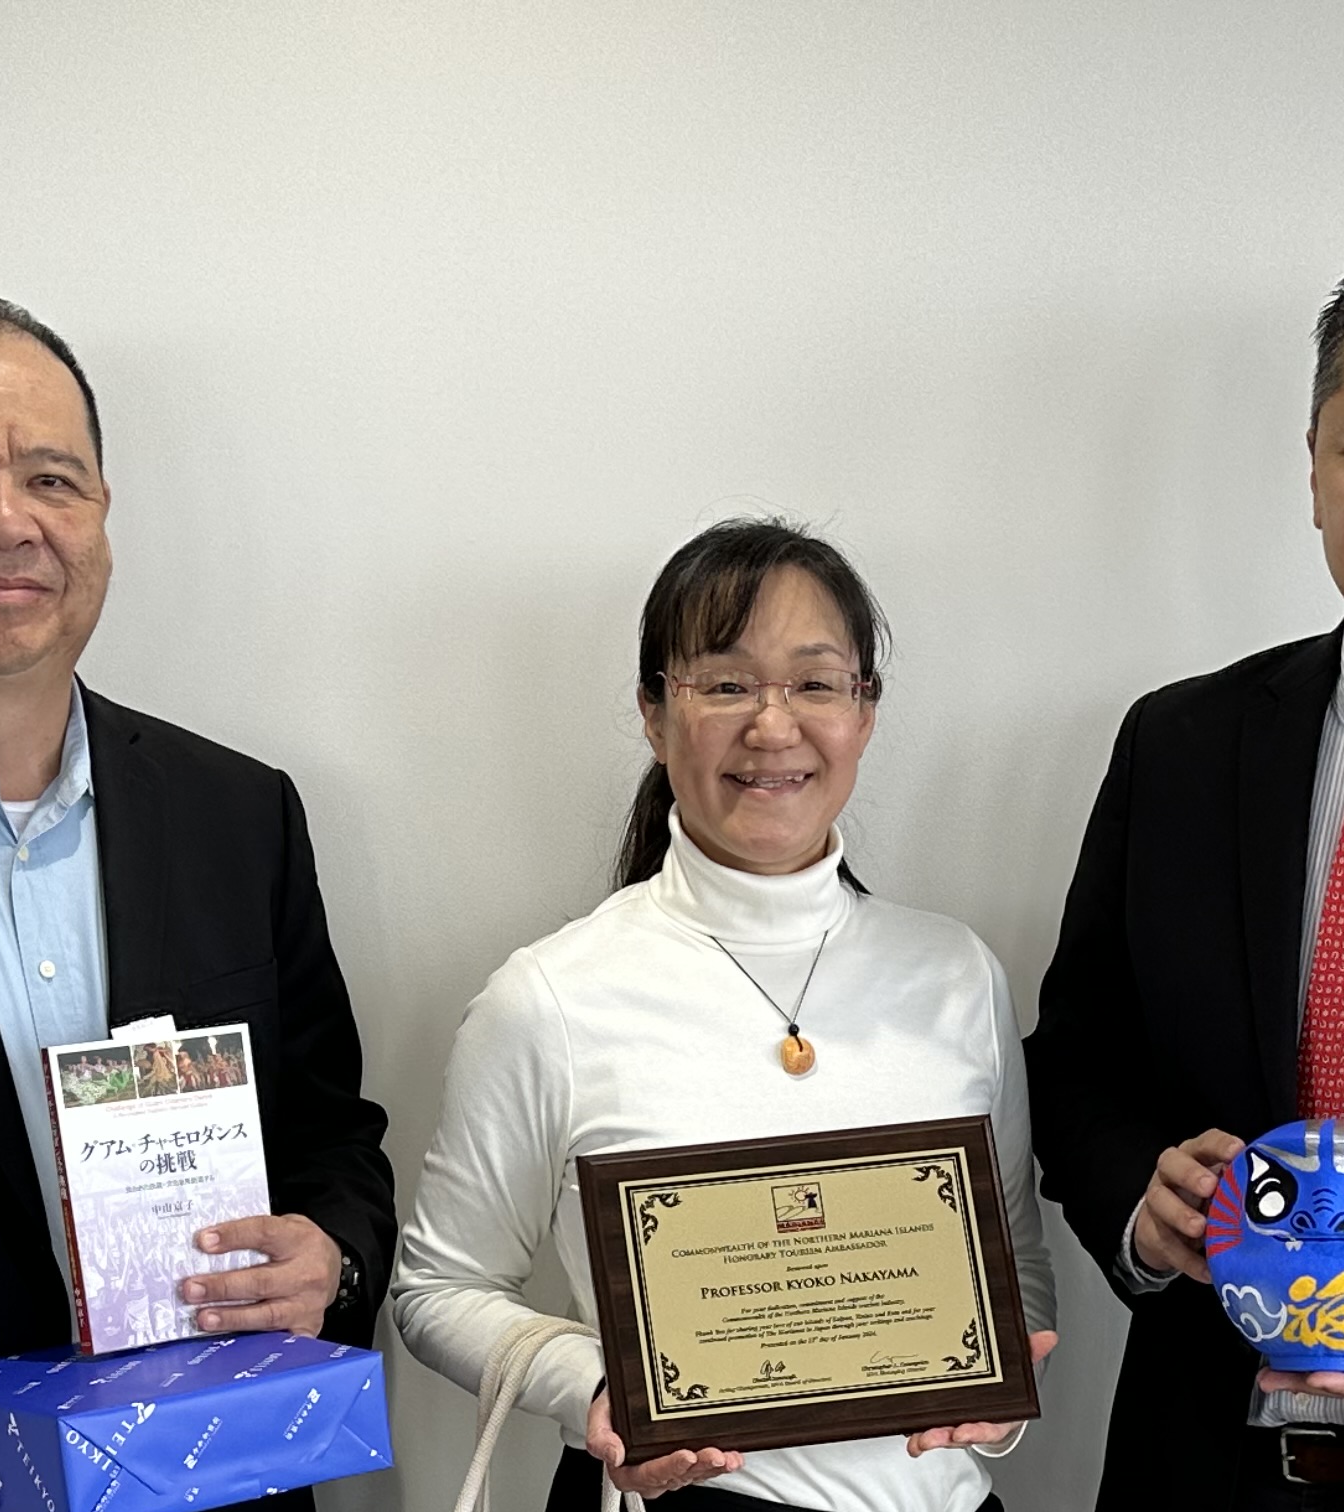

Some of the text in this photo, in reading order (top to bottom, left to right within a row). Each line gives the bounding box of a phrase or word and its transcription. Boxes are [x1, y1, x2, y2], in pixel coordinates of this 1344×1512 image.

[80, 1122, 248, 1163] グアム・チャモロダンス
[140, 1149, 197, 1175] の挑戦
[772, 1239, 791, 1248] THE
[794, 1233, 846, 1245] NORTHERN
[700, 1267, 919, 1300] PROFESSOR KYOKO NAKAYAMA
[17, 1439, 55, 1512] TEIKYO
